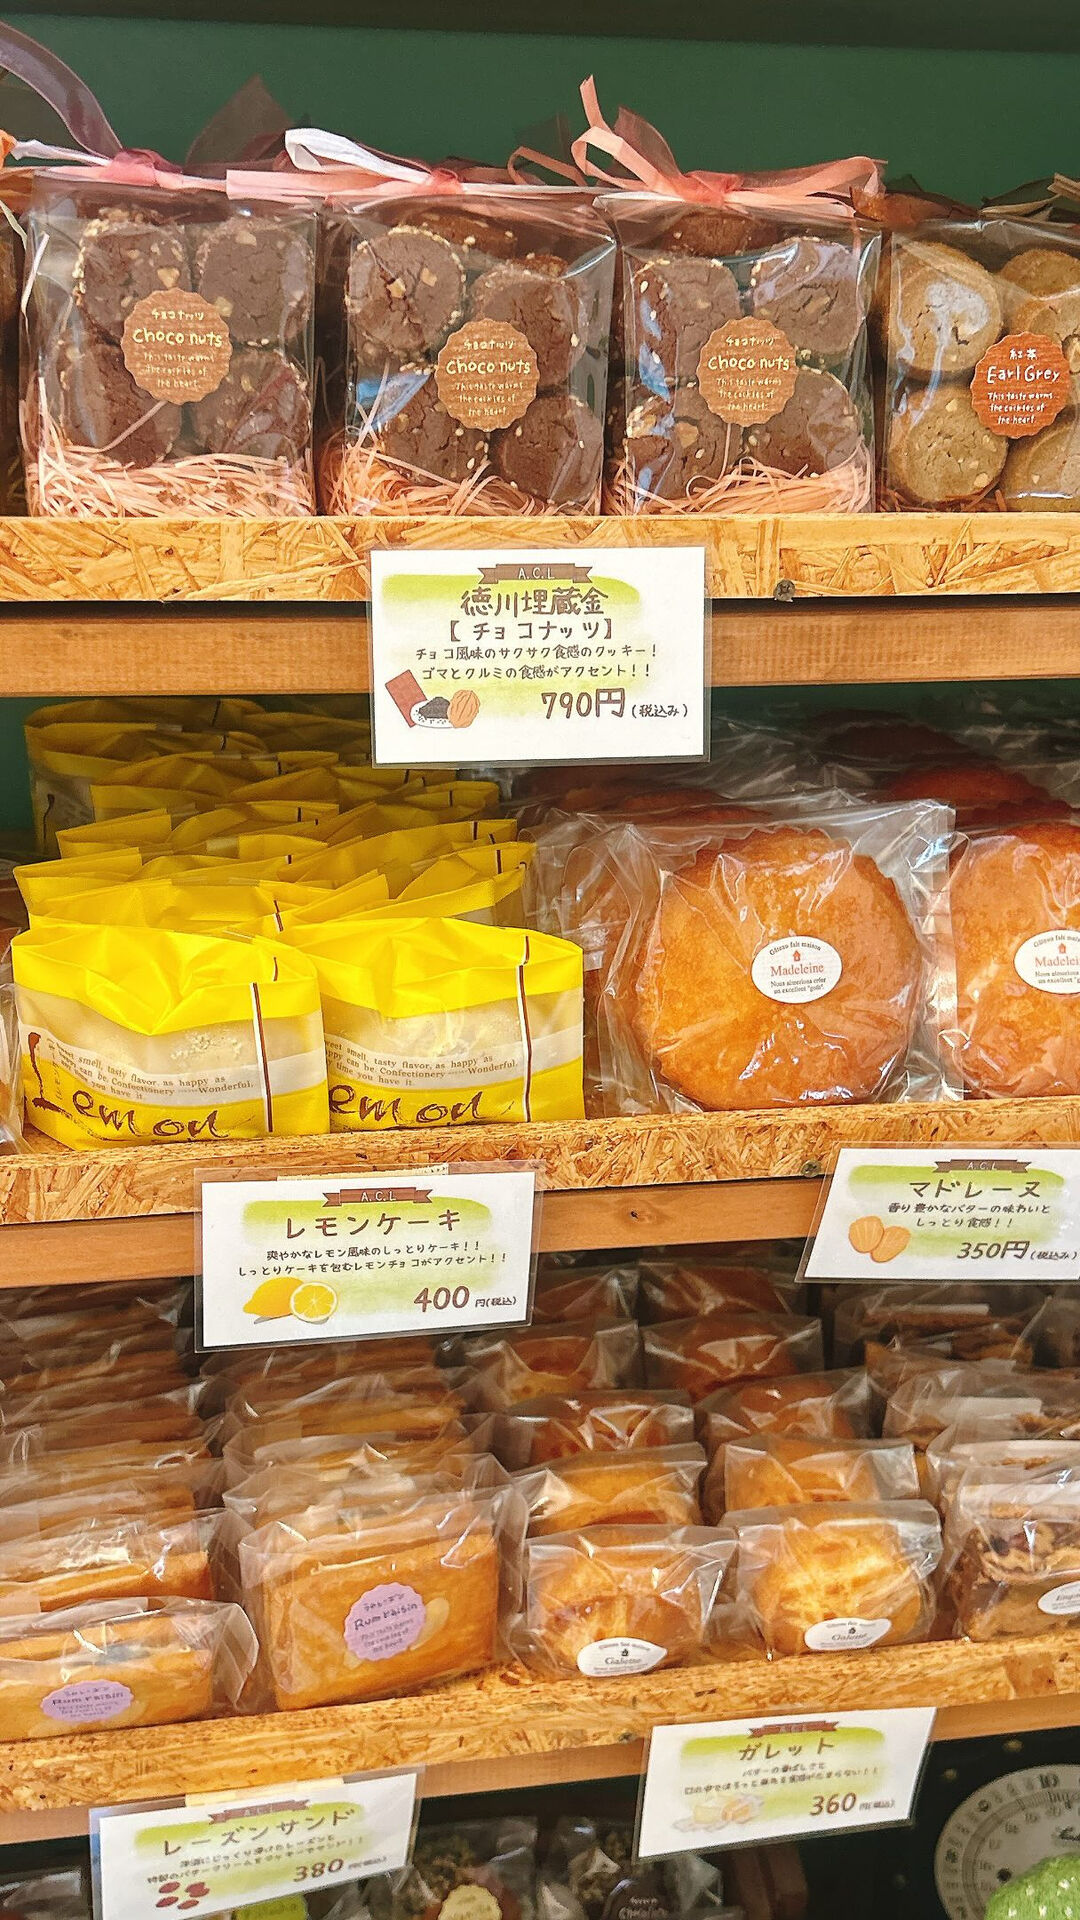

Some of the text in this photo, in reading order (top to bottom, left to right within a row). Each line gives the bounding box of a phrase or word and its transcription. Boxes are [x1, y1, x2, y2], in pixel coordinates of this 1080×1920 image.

[133, 328, 223, 348] Choco nuts
[446, 359, 531, 375] Choco nuts
[707, 355, 790, 371] Choco nuts
[987, 364, 1060, 384] Earl Grey
[460, 586, 609, 618] 徳川埋蔵金
[770, 962, 824, 977] Madeleine
[346, 1057, 360, 1068] can
[379, 1067, 446, 1079] Confectionery
[374, 1058, 397, 1068] tasty
[451, 1057, 478, 1069] happy
[483, 1055, 493, 1063] as
[107, 1066, 128, 1079] tasty
[179, 1077, 209, 1088] happy
[215, 1076, 226, 1084] as
[111, 1078, 175, 1096] Confectionery
[357, 1071, 373, 1081] you
[378, 1076, 400, 1086] have
[110, 1086, 131, 1098] have
[329, 1084, 486, 1124] emon
[909, 1179, 1041, 1199] マドレーヌ
[887, 1202, 1051, 1214] 香り豊かなバターの味わいと
[287, 1209, 461, 1239] レモンケーキ
[413, 1285, 470, 1313] 400
[739, 1737, 835, 1761] ガレット
[810, 1792, 857, 1817] 360
[164, 1808, 355, 1856] レーズンサンド
[293, 1858, 344, 1883] 380
